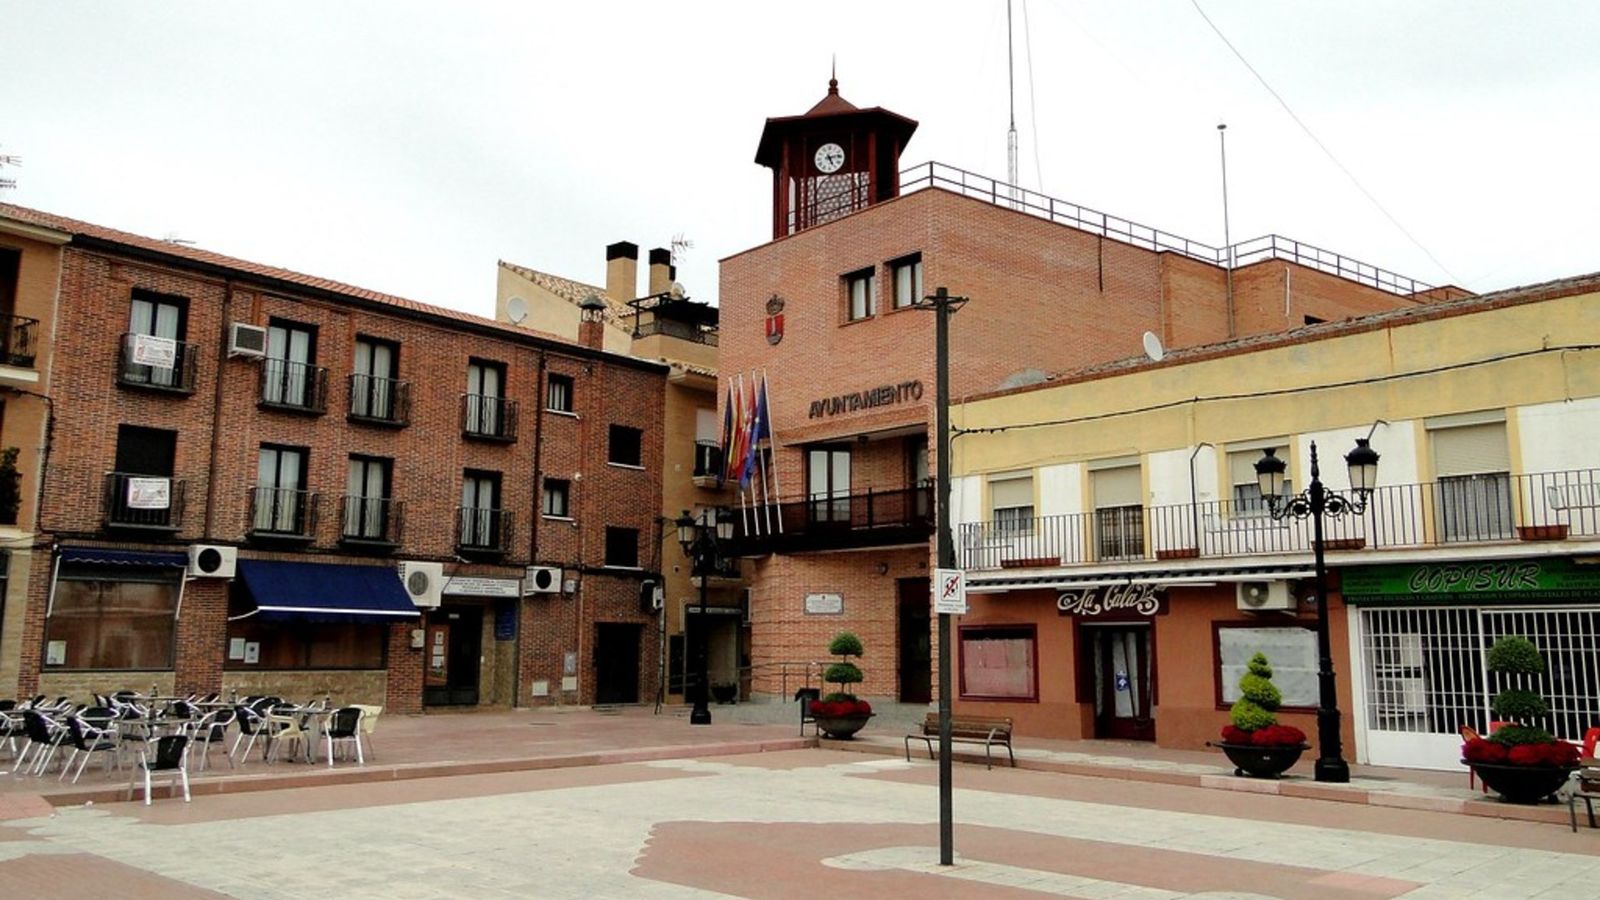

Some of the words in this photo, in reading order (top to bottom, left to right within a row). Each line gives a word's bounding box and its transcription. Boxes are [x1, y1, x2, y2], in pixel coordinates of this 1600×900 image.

[808, 379, 924, 419] AYUNTAMIENTO
[1407, 561, 1540, 593] COPISUR
[1057, 588, 1101, 615] La
